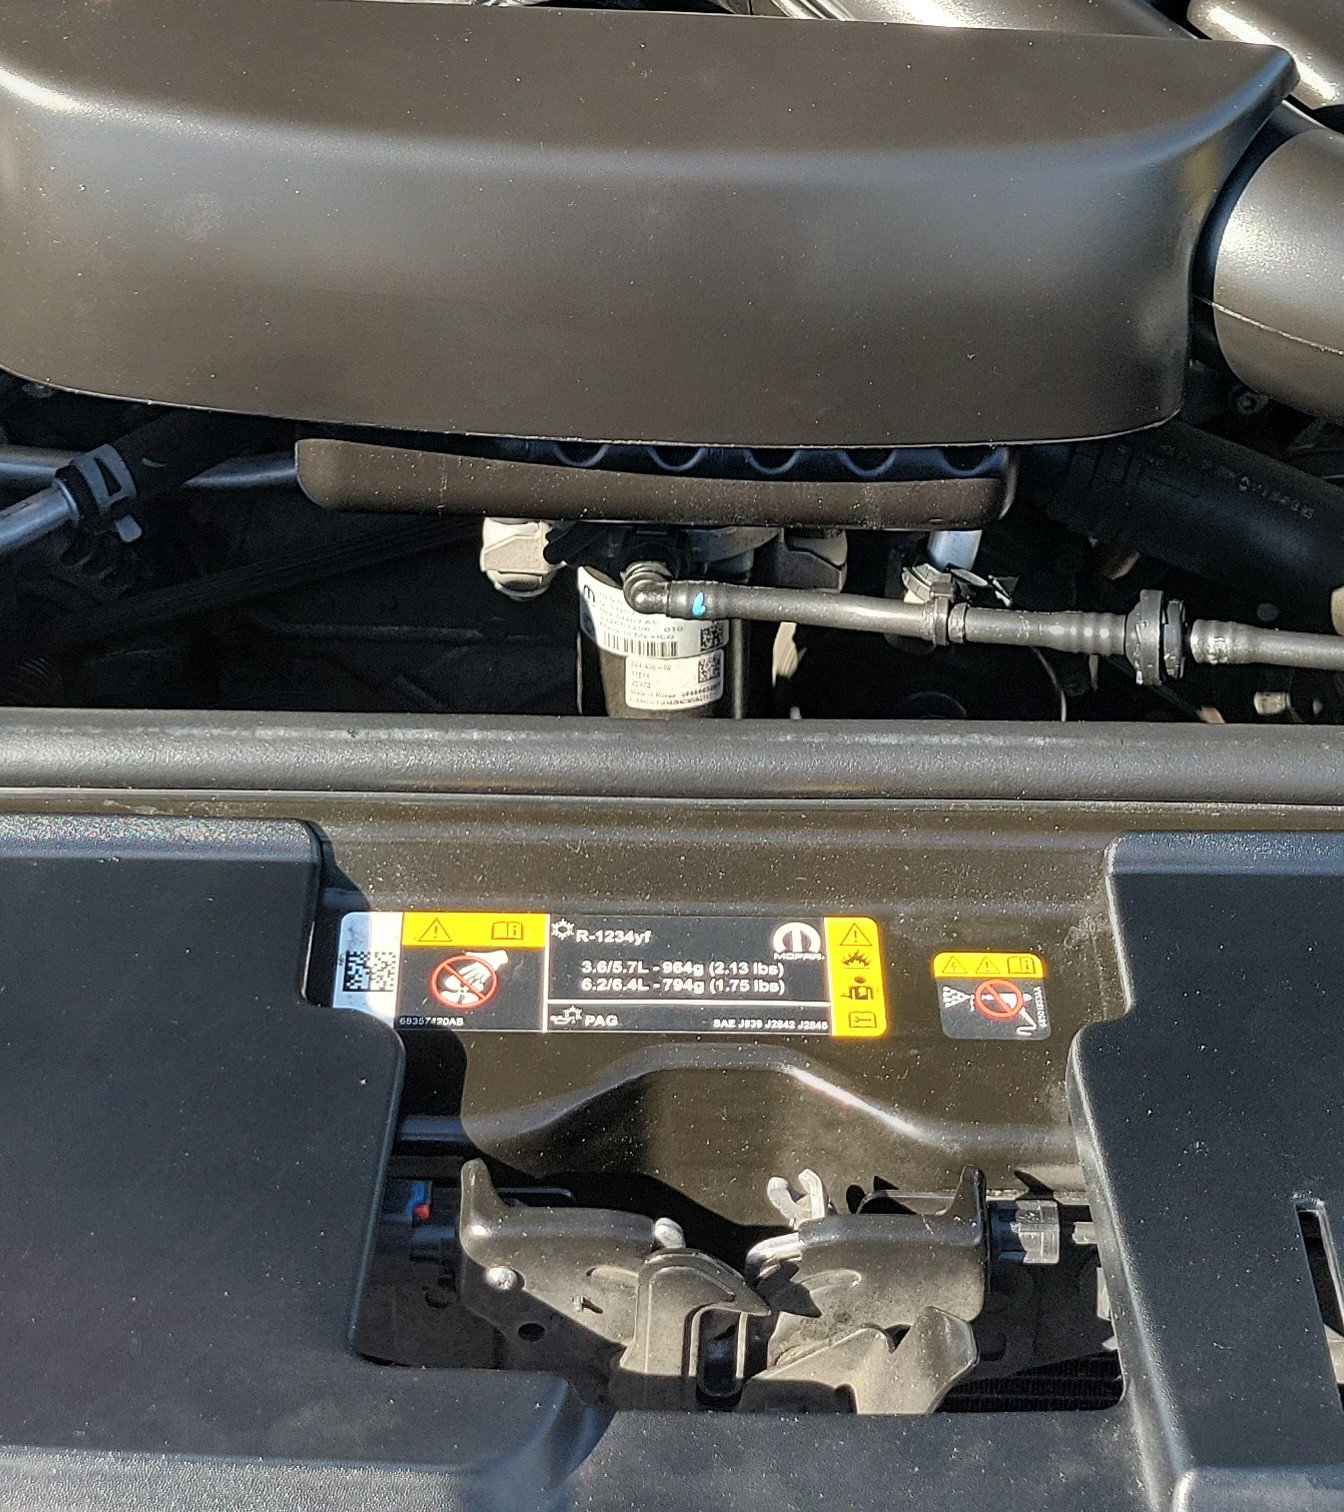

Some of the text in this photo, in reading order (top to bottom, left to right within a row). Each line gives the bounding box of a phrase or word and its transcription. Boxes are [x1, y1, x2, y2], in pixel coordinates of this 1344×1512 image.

[576, 929, 652, 946] R-1234yf
[581, 960, 649, 975] 3.6/5.7L
[708, 961, 750, 977] (2.13
[753, 961, 785, 977] lbs)
[581, 978, 650, 992] 6.2/6.4L
[664, 978, 705, 995] 794g
[709, 978, 750, 995] (1.75
[753, 978, 786, 995] lbs)
[584, 1015, 619, 1027] PAG
[713, 1018, 737, 1029] SAE
